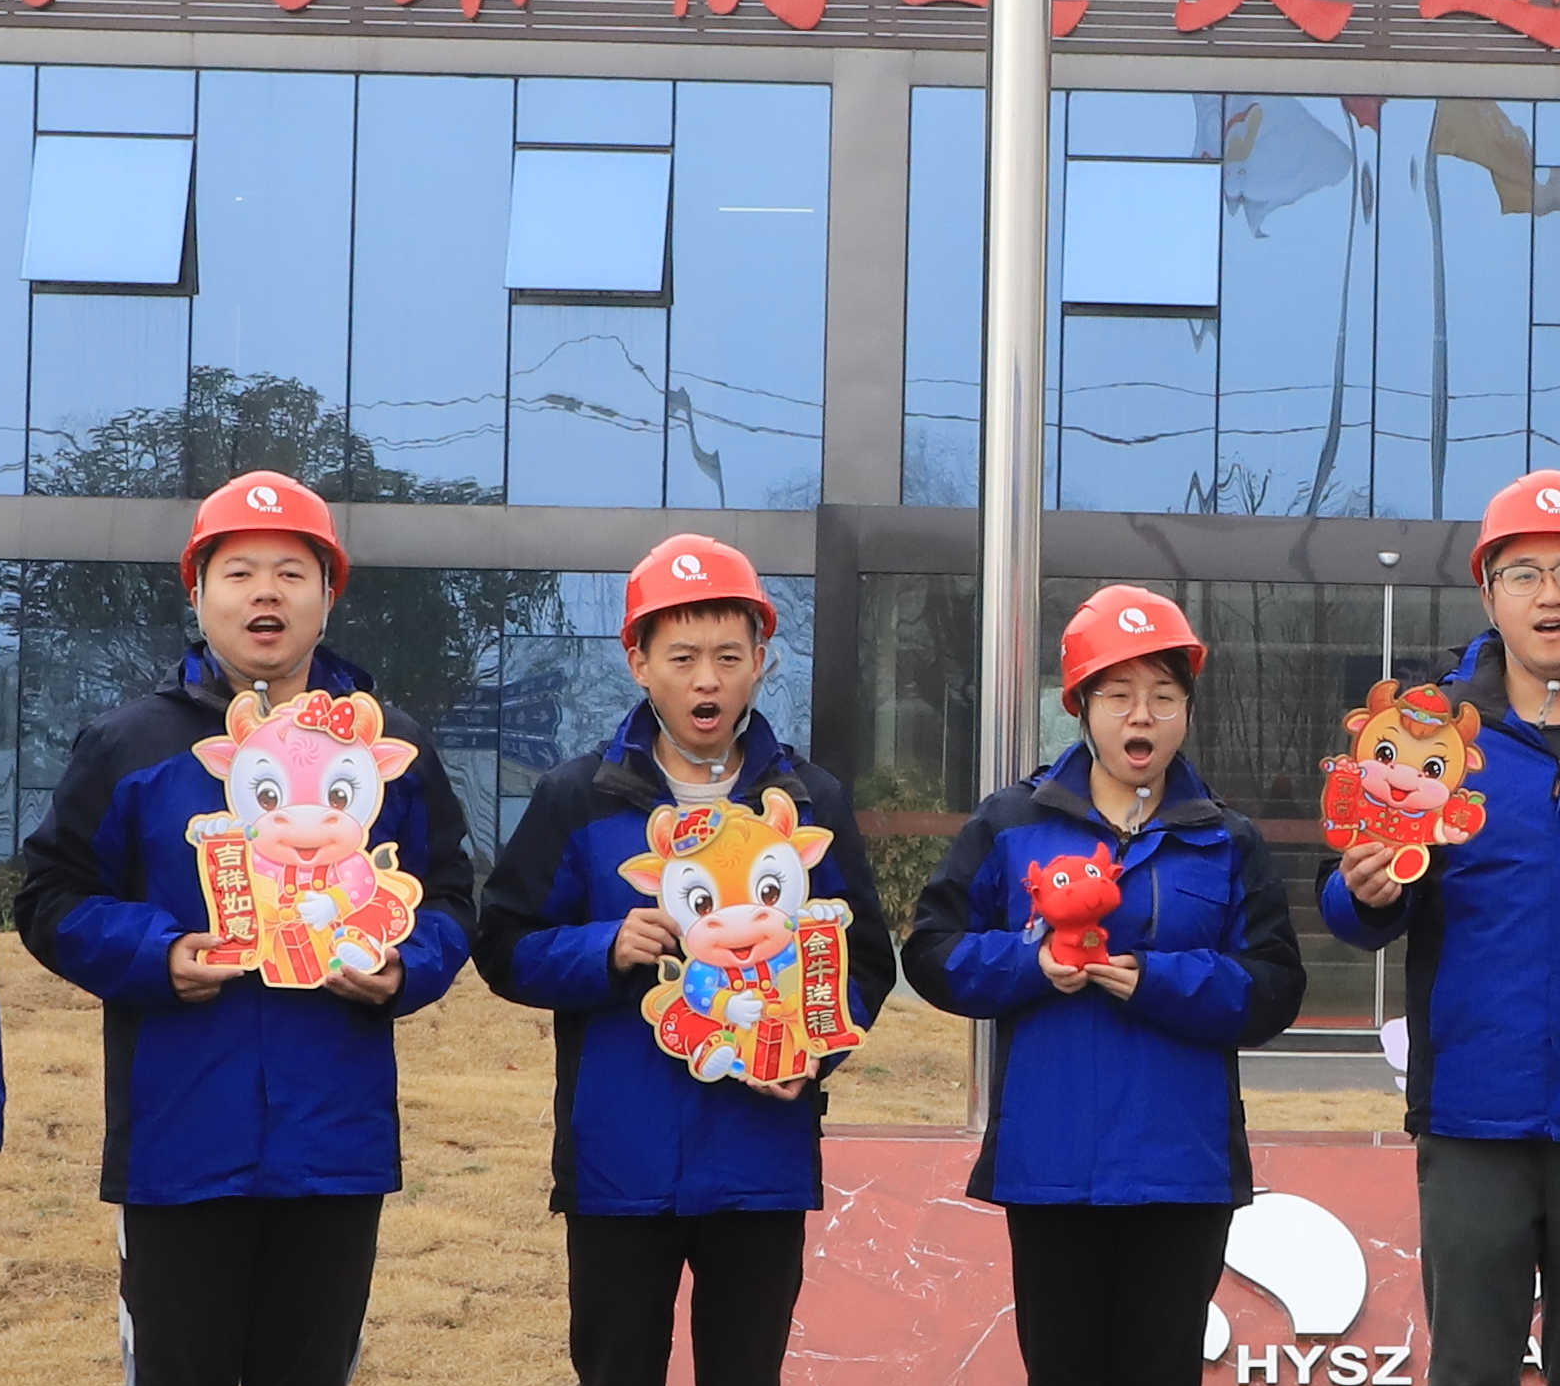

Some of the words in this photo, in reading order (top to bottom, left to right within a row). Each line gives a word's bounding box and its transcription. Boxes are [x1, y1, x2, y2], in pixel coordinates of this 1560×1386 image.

[214, 843, 256, 941] 吉祥如意
[802, 931, 838, 1034] 金牛送福
[1236, 1344, 1412, 1386] HYSZ
